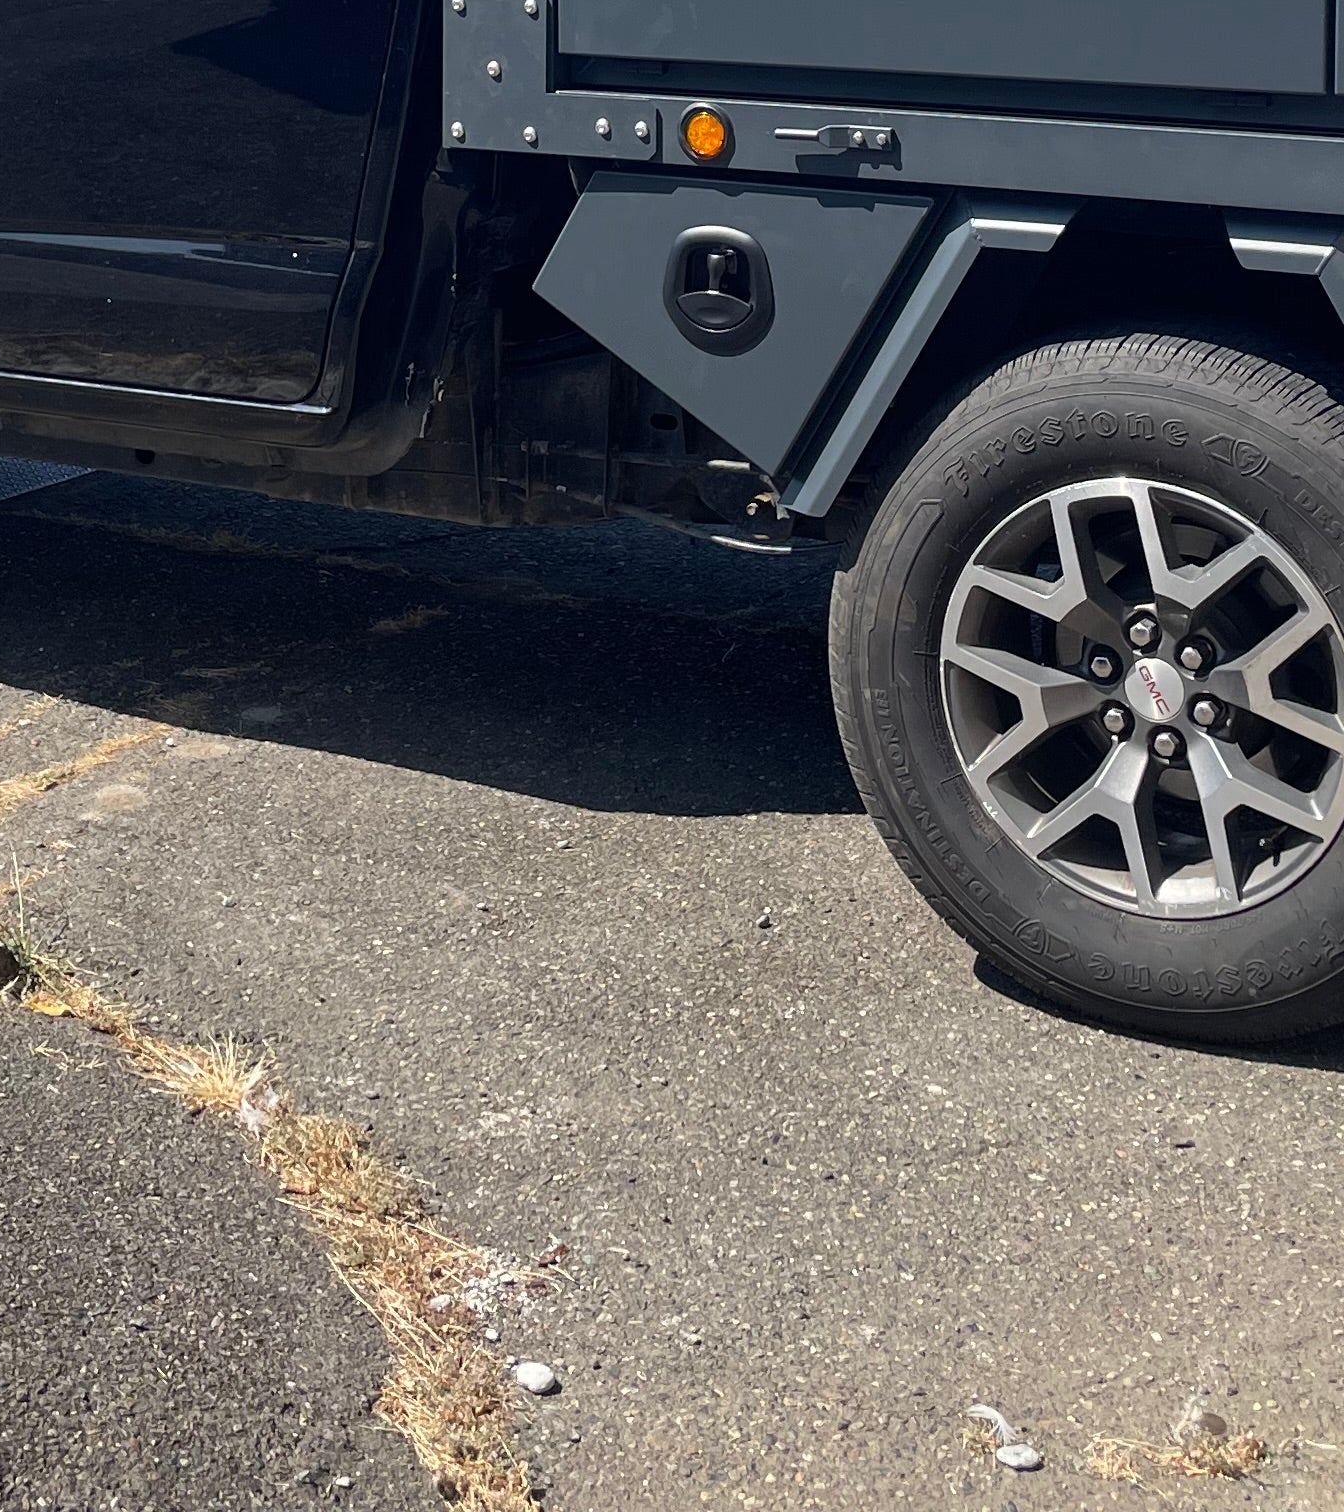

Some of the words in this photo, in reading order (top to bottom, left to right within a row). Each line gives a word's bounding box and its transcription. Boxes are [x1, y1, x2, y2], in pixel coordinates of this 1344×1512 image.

[942, 406, 1190, 498] Firestone
[1138, 664, 1172, 716] GMC
[879, 722, 992, 904] DESTINATION
